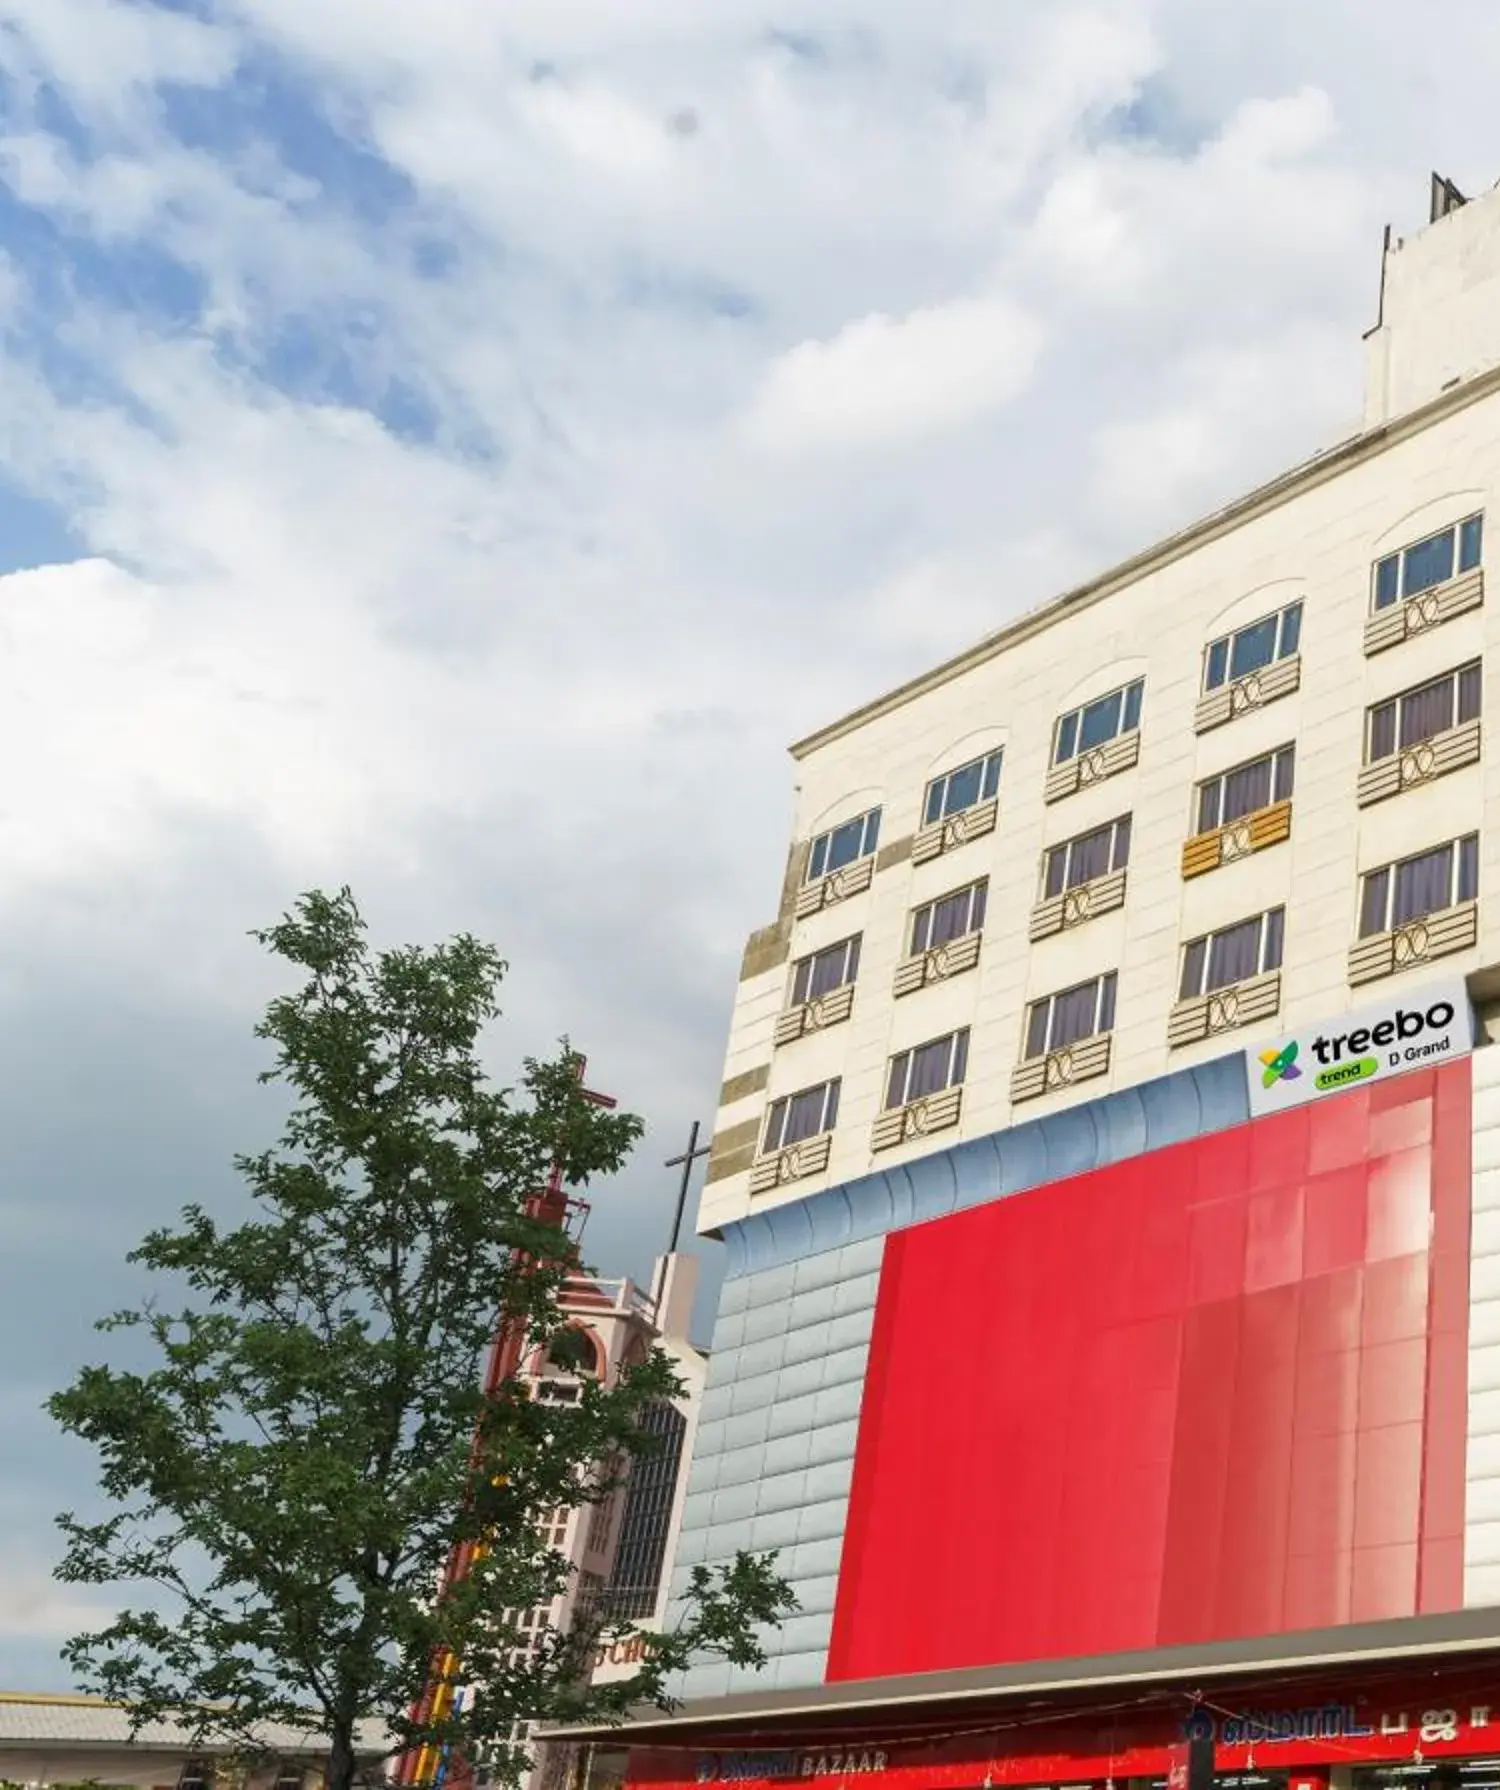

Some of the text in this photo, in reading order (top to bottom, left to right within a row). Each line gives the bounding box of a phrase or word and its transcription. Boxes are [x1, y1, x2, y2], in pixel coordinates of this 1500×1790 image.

[1311, 1001, 1455, 1064] treebo
[1388, 1036, 1451, 1067] D Grand
[1319, 1063, 1362, 1086] trend
[801, 1751, 889, 1777] BAZAAR
